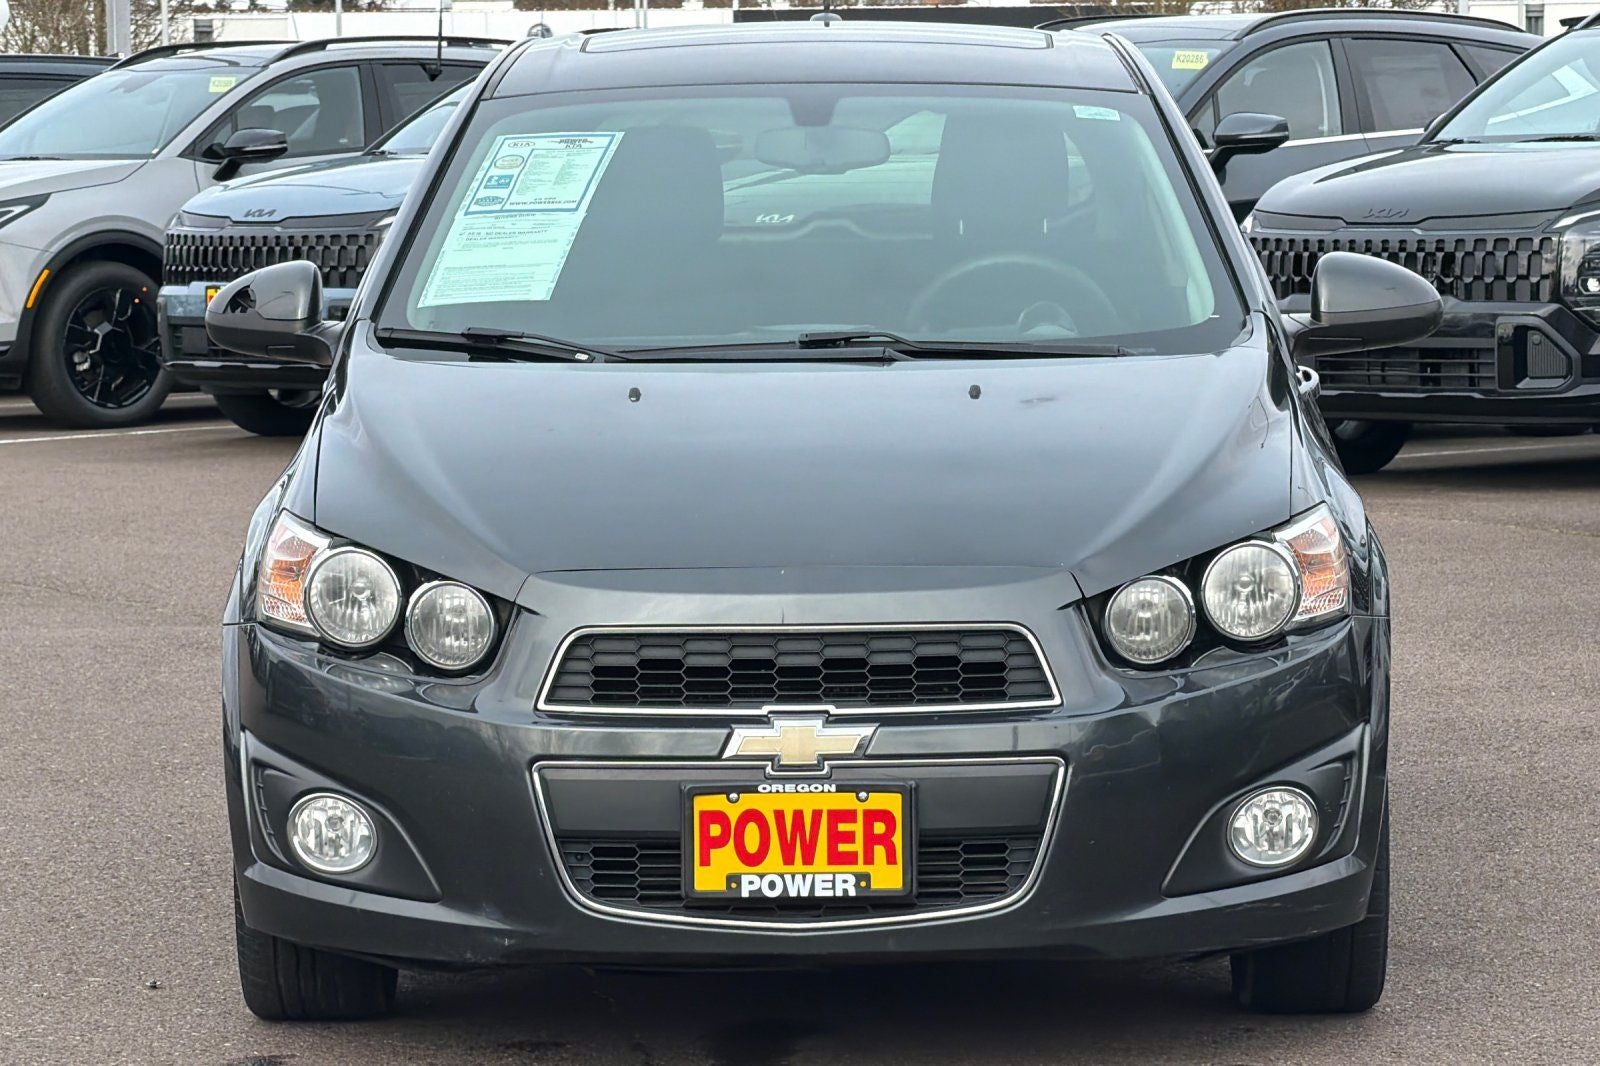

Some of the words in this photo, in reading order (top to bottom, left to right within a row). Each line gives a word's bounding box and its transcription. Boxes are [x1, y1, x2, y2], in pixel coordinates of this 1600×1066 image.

[243, 209, 277, 218] KIA
[757, 783, 837, 793] OREGON
[698, 808, 898, 868] POWER
[740, 873, 857, 898] POWER
